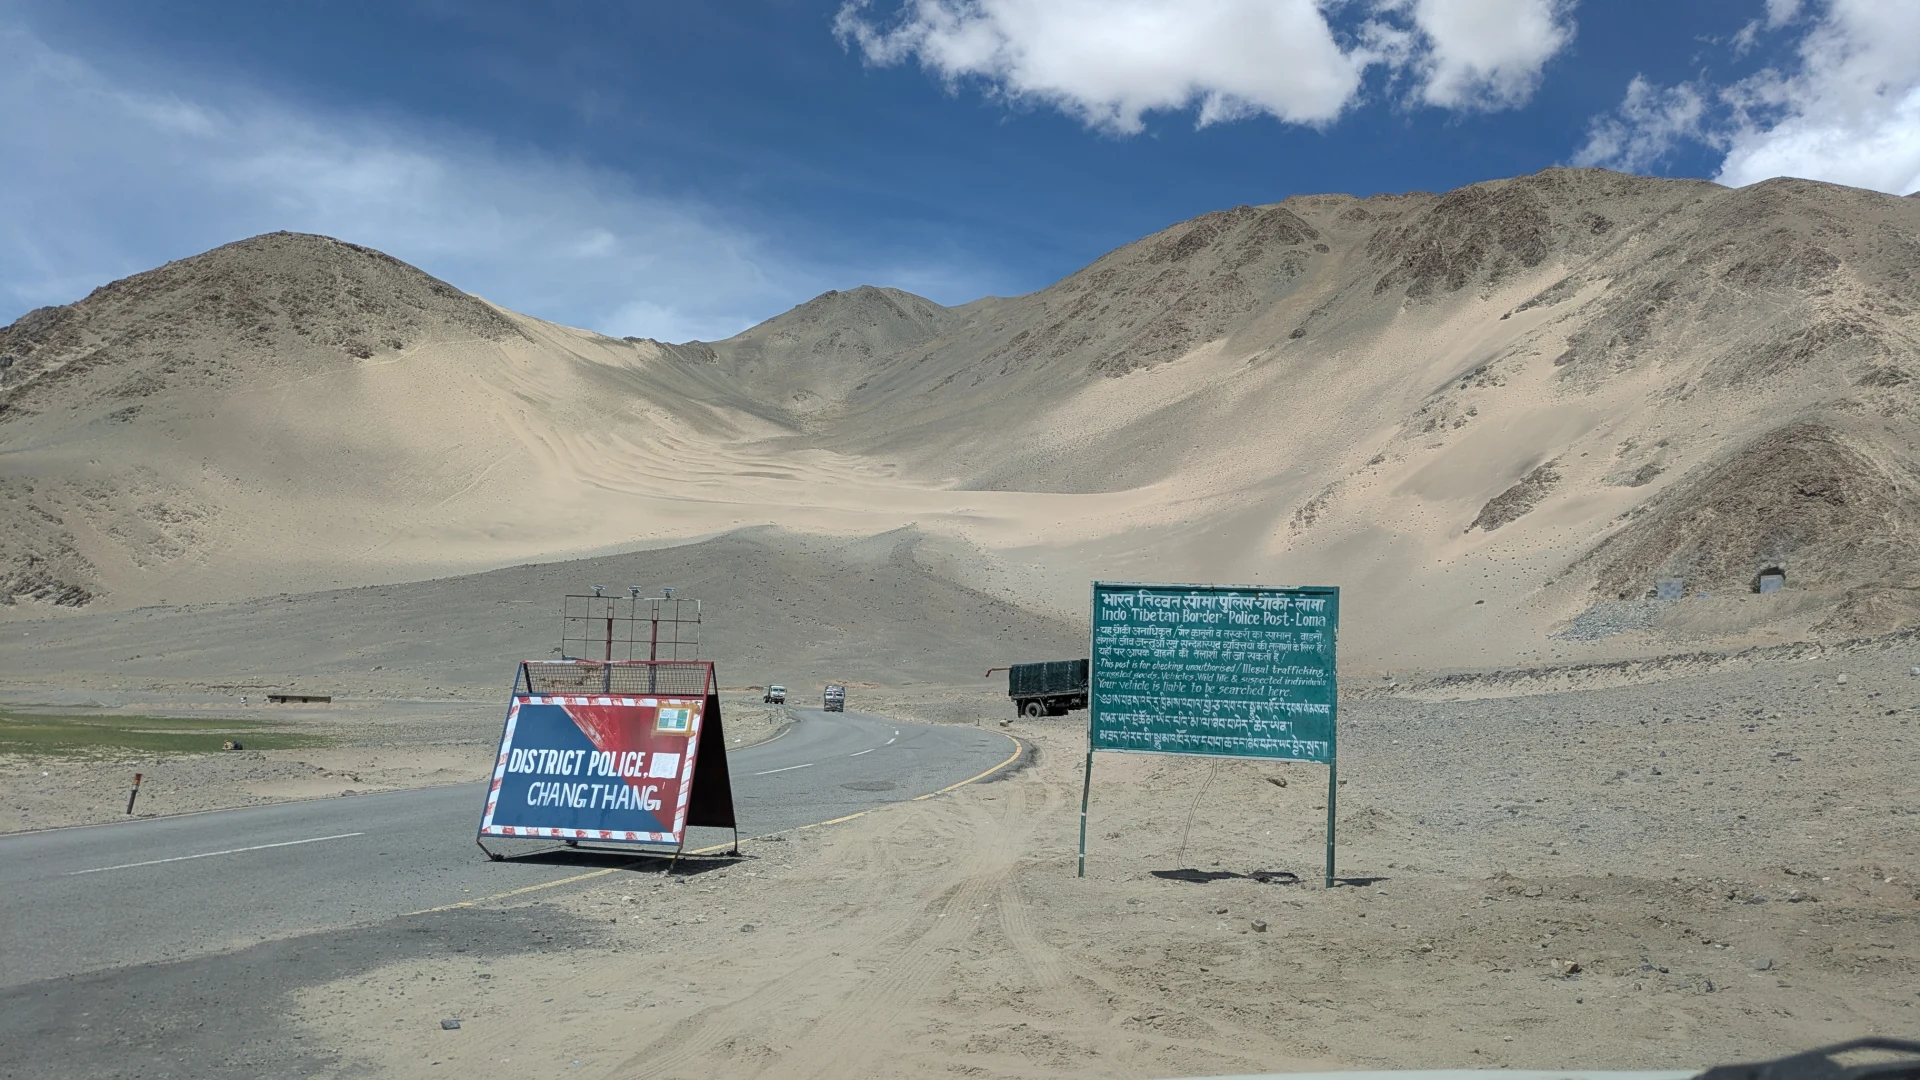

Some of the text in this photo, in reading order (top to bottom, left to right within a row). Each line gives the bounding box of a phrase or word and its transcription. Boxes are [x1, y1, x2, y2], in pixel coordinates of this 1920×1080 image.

[1101, 593, 1134, 608] भारत
[1182, 592, 1218, 611] सीमा
[1218, 592, 1256, 613] पुलिस
[1252, 630, 1262, 640] का
[1257, 640, 1268, 650] की
[1113, 648, 1126, 658] पर
[1178, 648, 1190, 658] की
[1232, 651, 1245, 661] जा
[1115, 660, 1130, 670] post
[1132, 660, 1138, 668] is
[1140, 660, 1150, 669] for
[1152, 661, 1184, 672] checking
[1096, 670, 1133, 679] smuggled
[1230, 674, 1238, 683] &
[1240, 676, 1283, 685] suspected
[1284, 676, 1327, 686] individuals
[1098, 678, 1117, 689] Your
[1118, 680, 1150, 690] vehicle
[1152, 681, 1160, 692] is
[1162, 682, 1186, 692] liable
[1192, 682, 1202, 693] to
[1204, 682, 1215, 694] be
[1218, 685, 1265, 696] searched
[508, 748, 586, 775] DISTRICT
